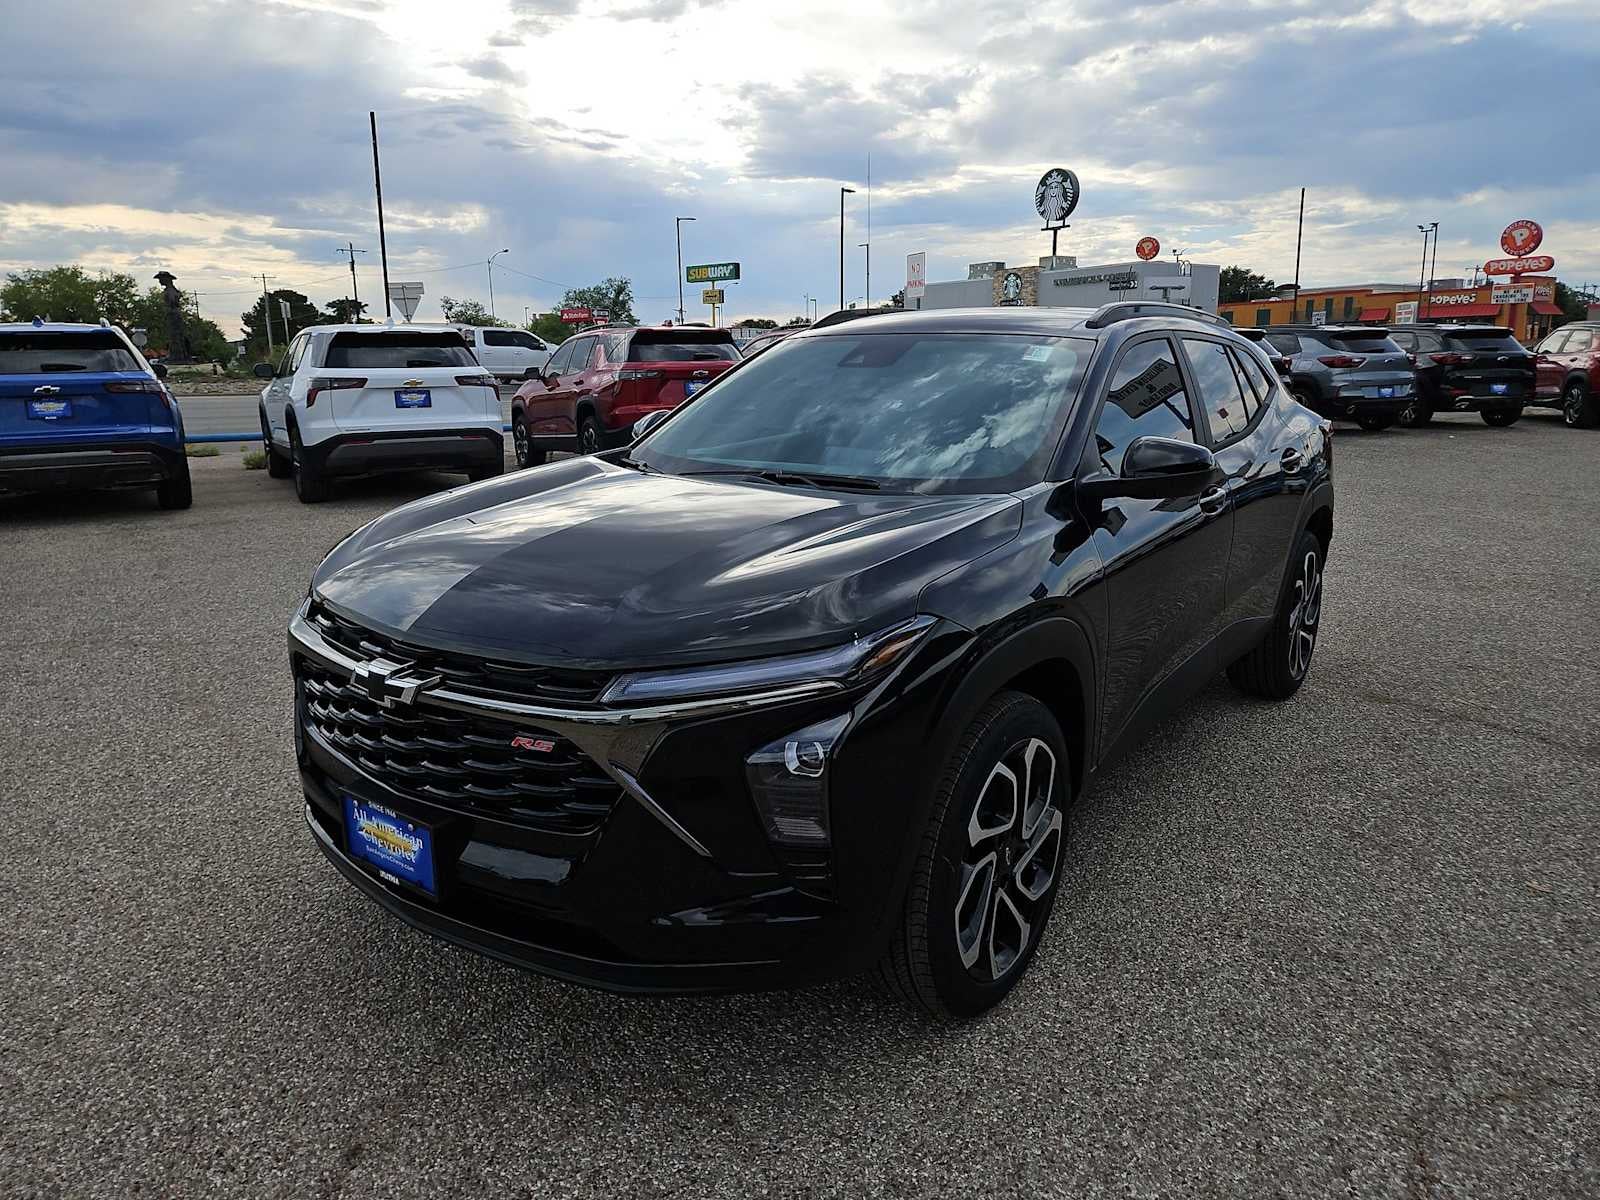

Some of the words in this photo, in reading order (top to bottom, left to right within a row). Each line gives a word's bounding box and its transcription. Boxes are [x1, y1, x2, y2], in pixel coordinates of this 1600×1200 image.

[688, 265, 730, 280] SUBWAY
[911, 263, 921, 273] NO
[511, 736, 555, 752] RS
